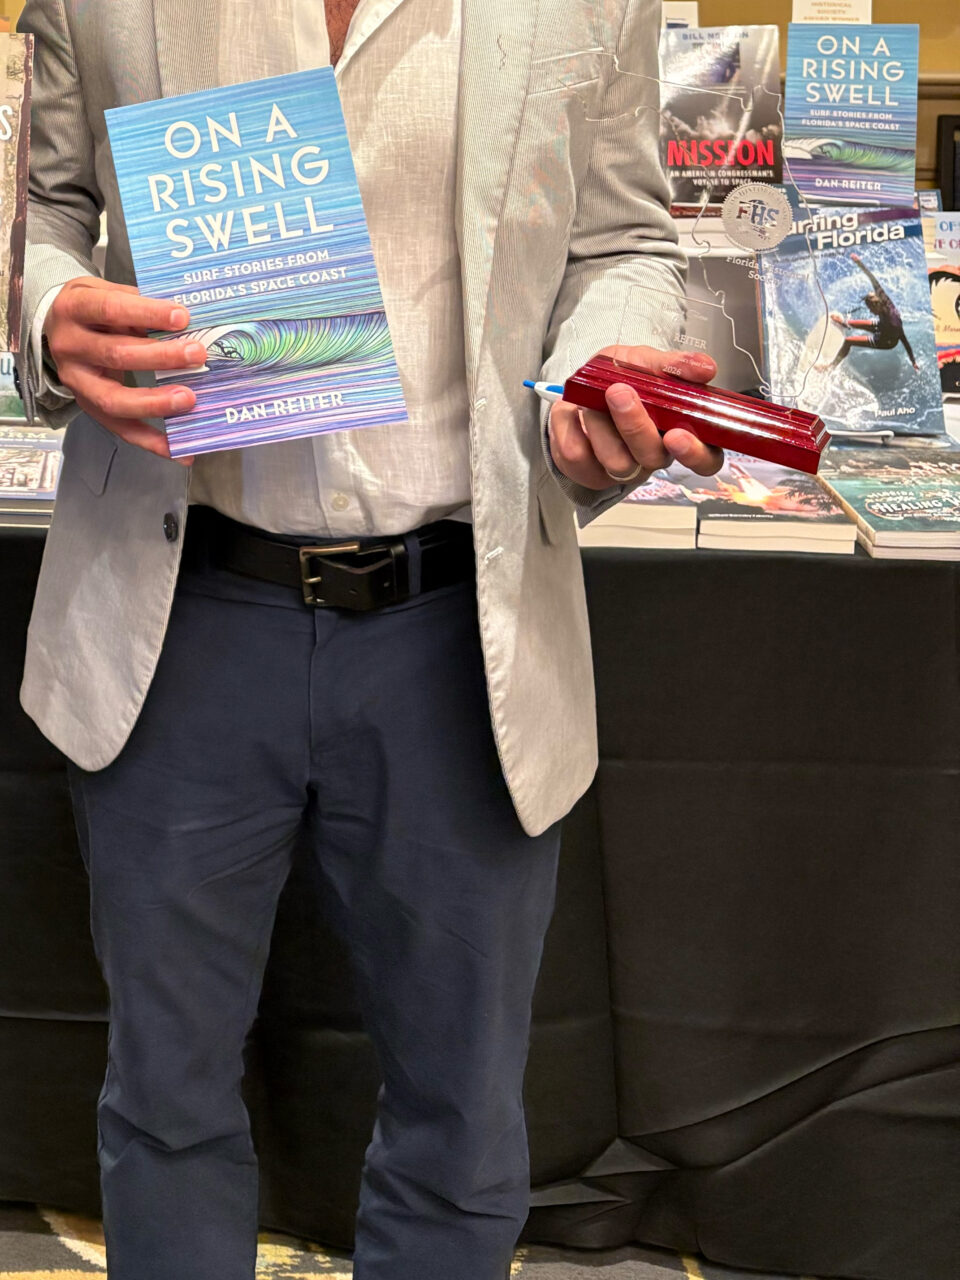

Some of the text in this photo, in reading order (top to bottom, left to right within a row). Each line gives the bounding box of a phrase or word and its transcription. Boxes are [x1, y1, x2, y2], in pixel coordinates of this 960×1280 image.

[817, 35, 891, 57] ON A
[802, 58, 904, 82] RISING
[806, 82, 899, 106] SWELL
[802, 118, 900, 131] FLORIDA'S SPACE COAST
[810, 109, 893, 120] SURF STORIES FROM
[164, 102, 298, 159] ON A
[667, 139, 775, 167] MISSION
[148, 146, 329, 212] RISING
[718, 170, 774, 178] CONGRESSMAN'S
[720, 178, 730, 186] TO
[815, 178, 881, 191] DAN REITER
[736, 203, 779, 227] FHS
[787, 212, 858, 235] urfing
[166, 196, 334, 258] SWELL
[817, 223, 905, 250] Florida
[184, 250, 330, 284] SURF STORIES FROM
[726, 256, 759, 270] Florida
[173, 266, 348, 306] FLORIDA'S SPACE COAST
[674, 334, 708, 350] REITER
[225, 392, 344, 424] DAN REITER
[874, 407, 916, 418] Paul Aho
[878, 500, 943, 513] HEALING
